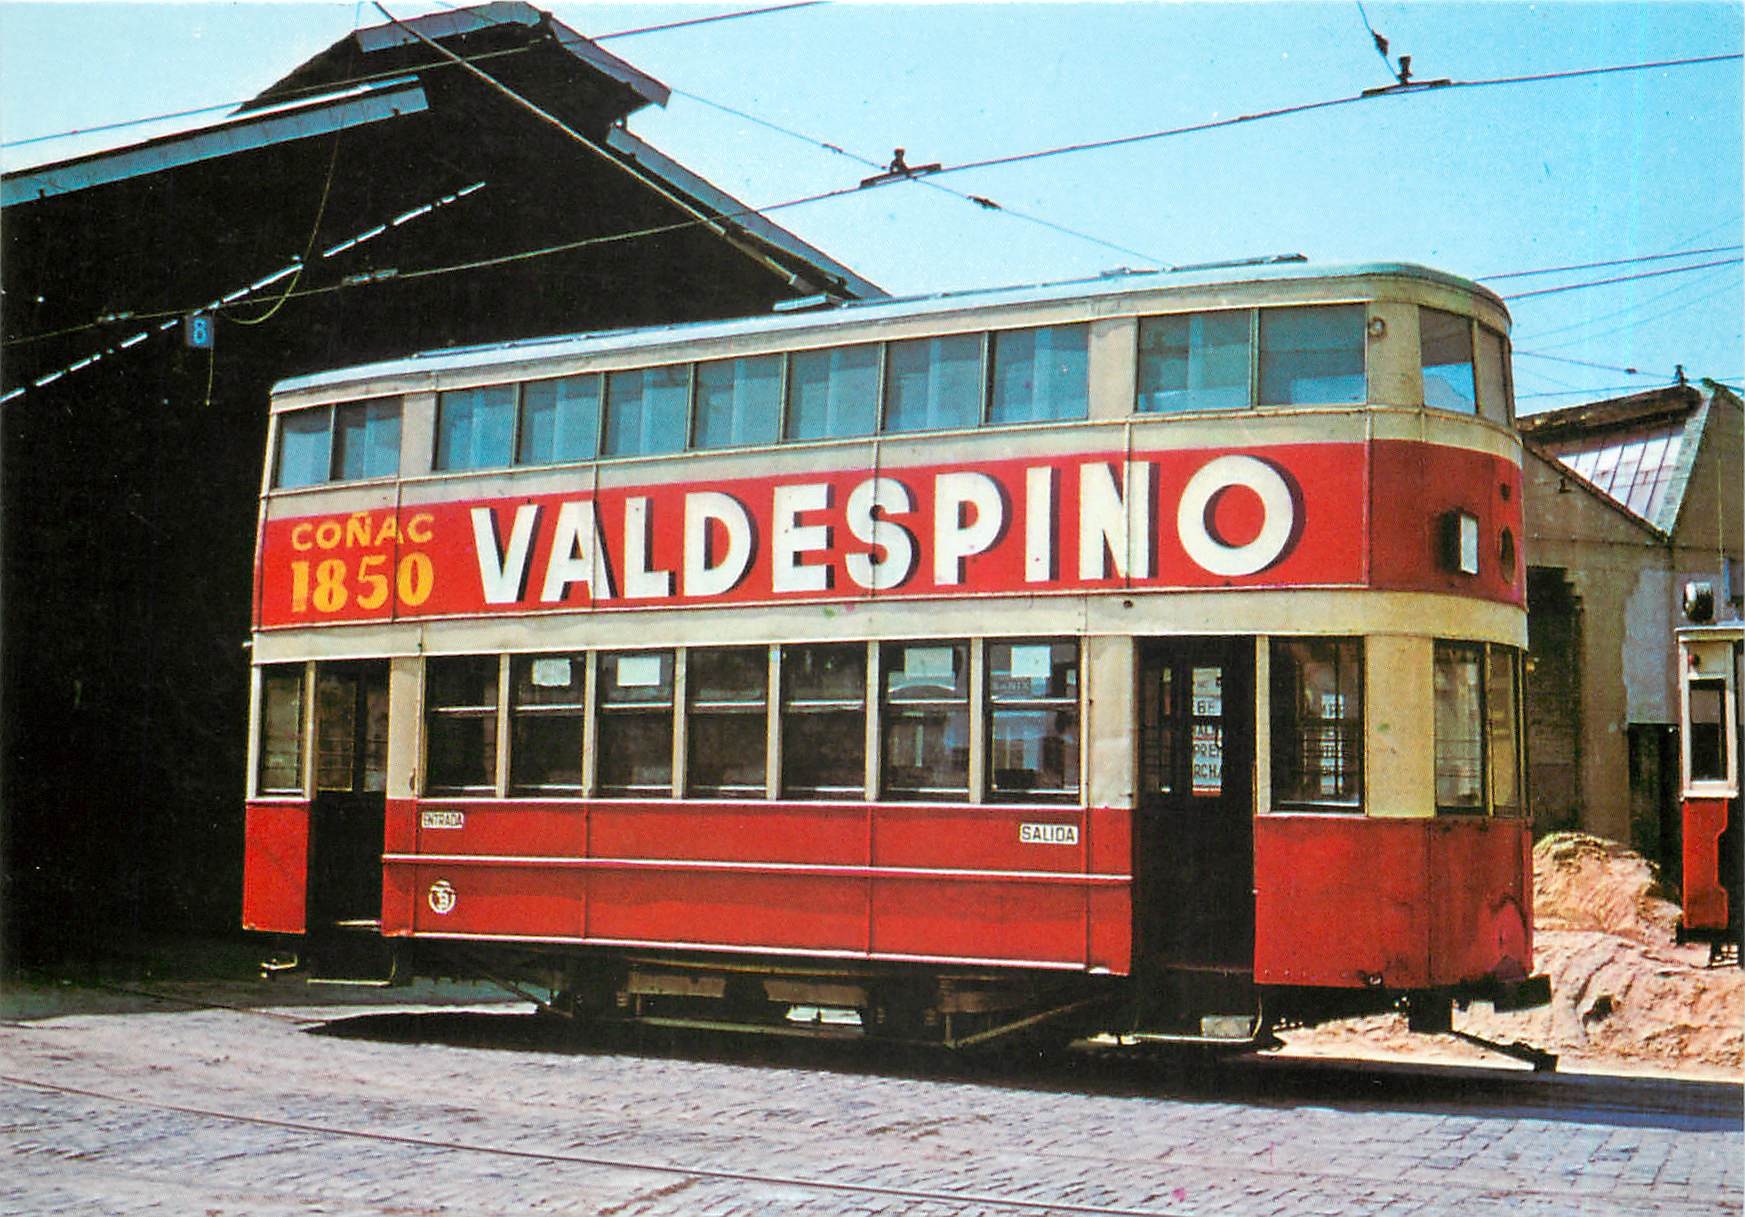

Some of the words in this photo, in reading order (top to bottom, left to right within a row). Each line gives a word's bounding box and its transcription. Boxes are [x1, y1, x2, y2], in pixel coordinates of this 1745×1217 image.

[291, 511, 435, 551] COÑAC
[470, 453, 1300, 605] VALDESPINO
[291, 552, 435, 613] 1850
[424, 812, 462, 826] ENTRADA
[1021, 825, 1075, 843] SALIDA
